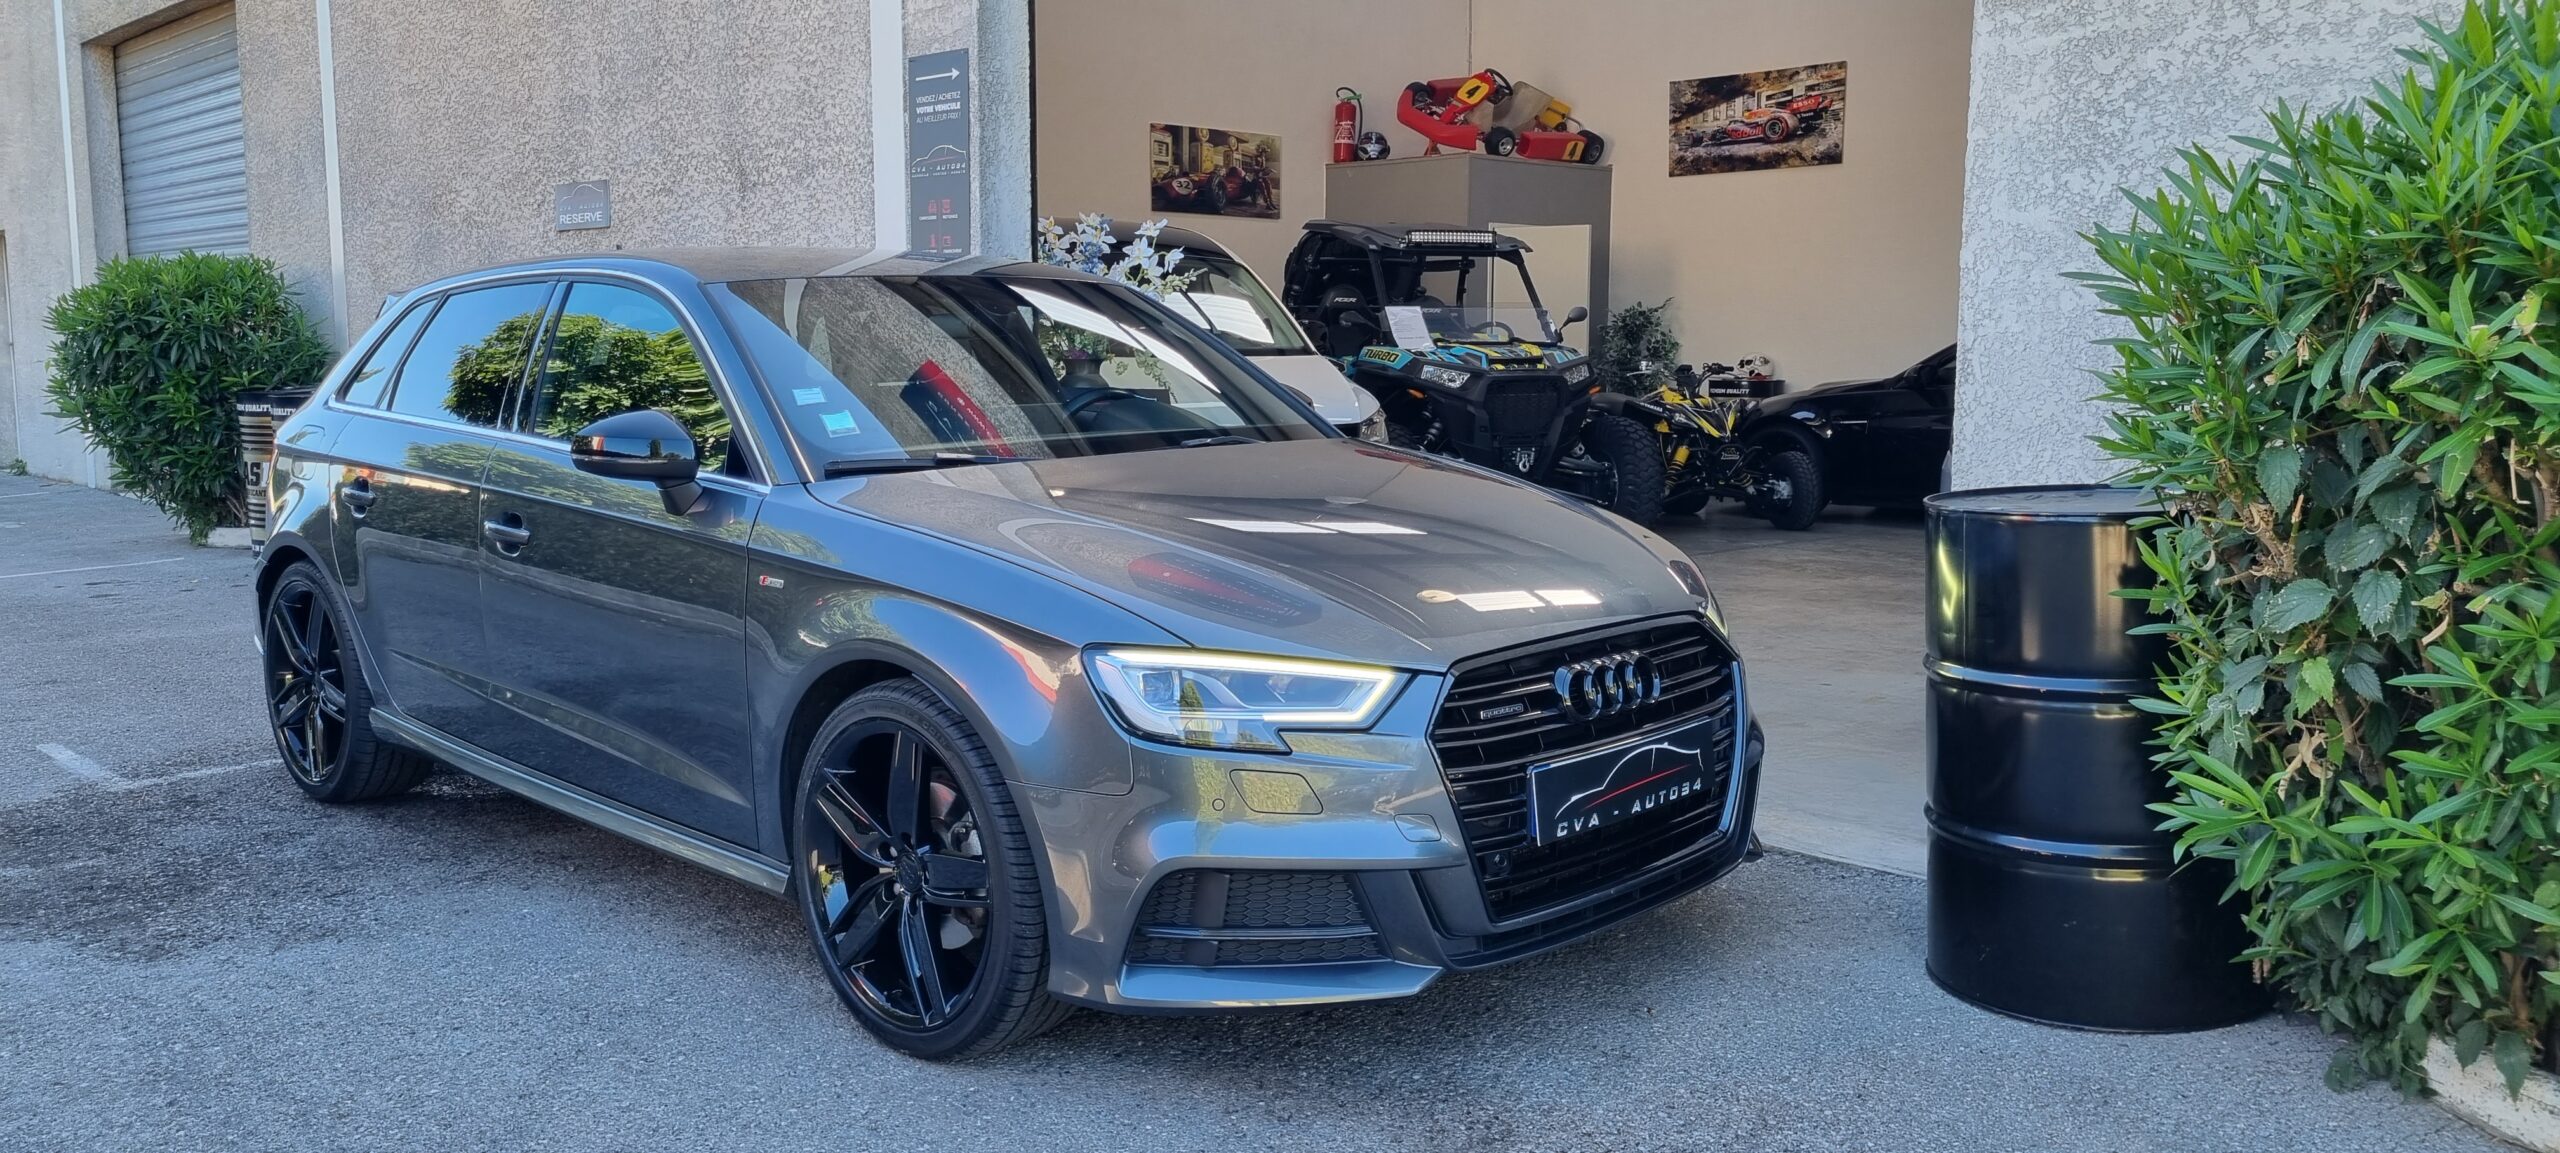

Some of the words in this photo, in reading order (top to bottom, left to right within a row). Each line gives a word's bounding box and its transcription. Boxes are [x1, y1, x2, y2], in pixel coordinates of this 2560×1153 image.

[1465, 85, 1482, 99] 4
[916, 105, 934, 114] VOTRE
[1567, 142, 1579, 160] 4
[1175, 180, 1191, 190] 32
[560, 211, 603, 225] RESERVE
[1364, 349, 1400, 363] TURBO
[1483, 705, 1522, 719] quattro
[1556, 813, 1600, 838] CVA
[1631, 777, 1702, 815] AUTO34
